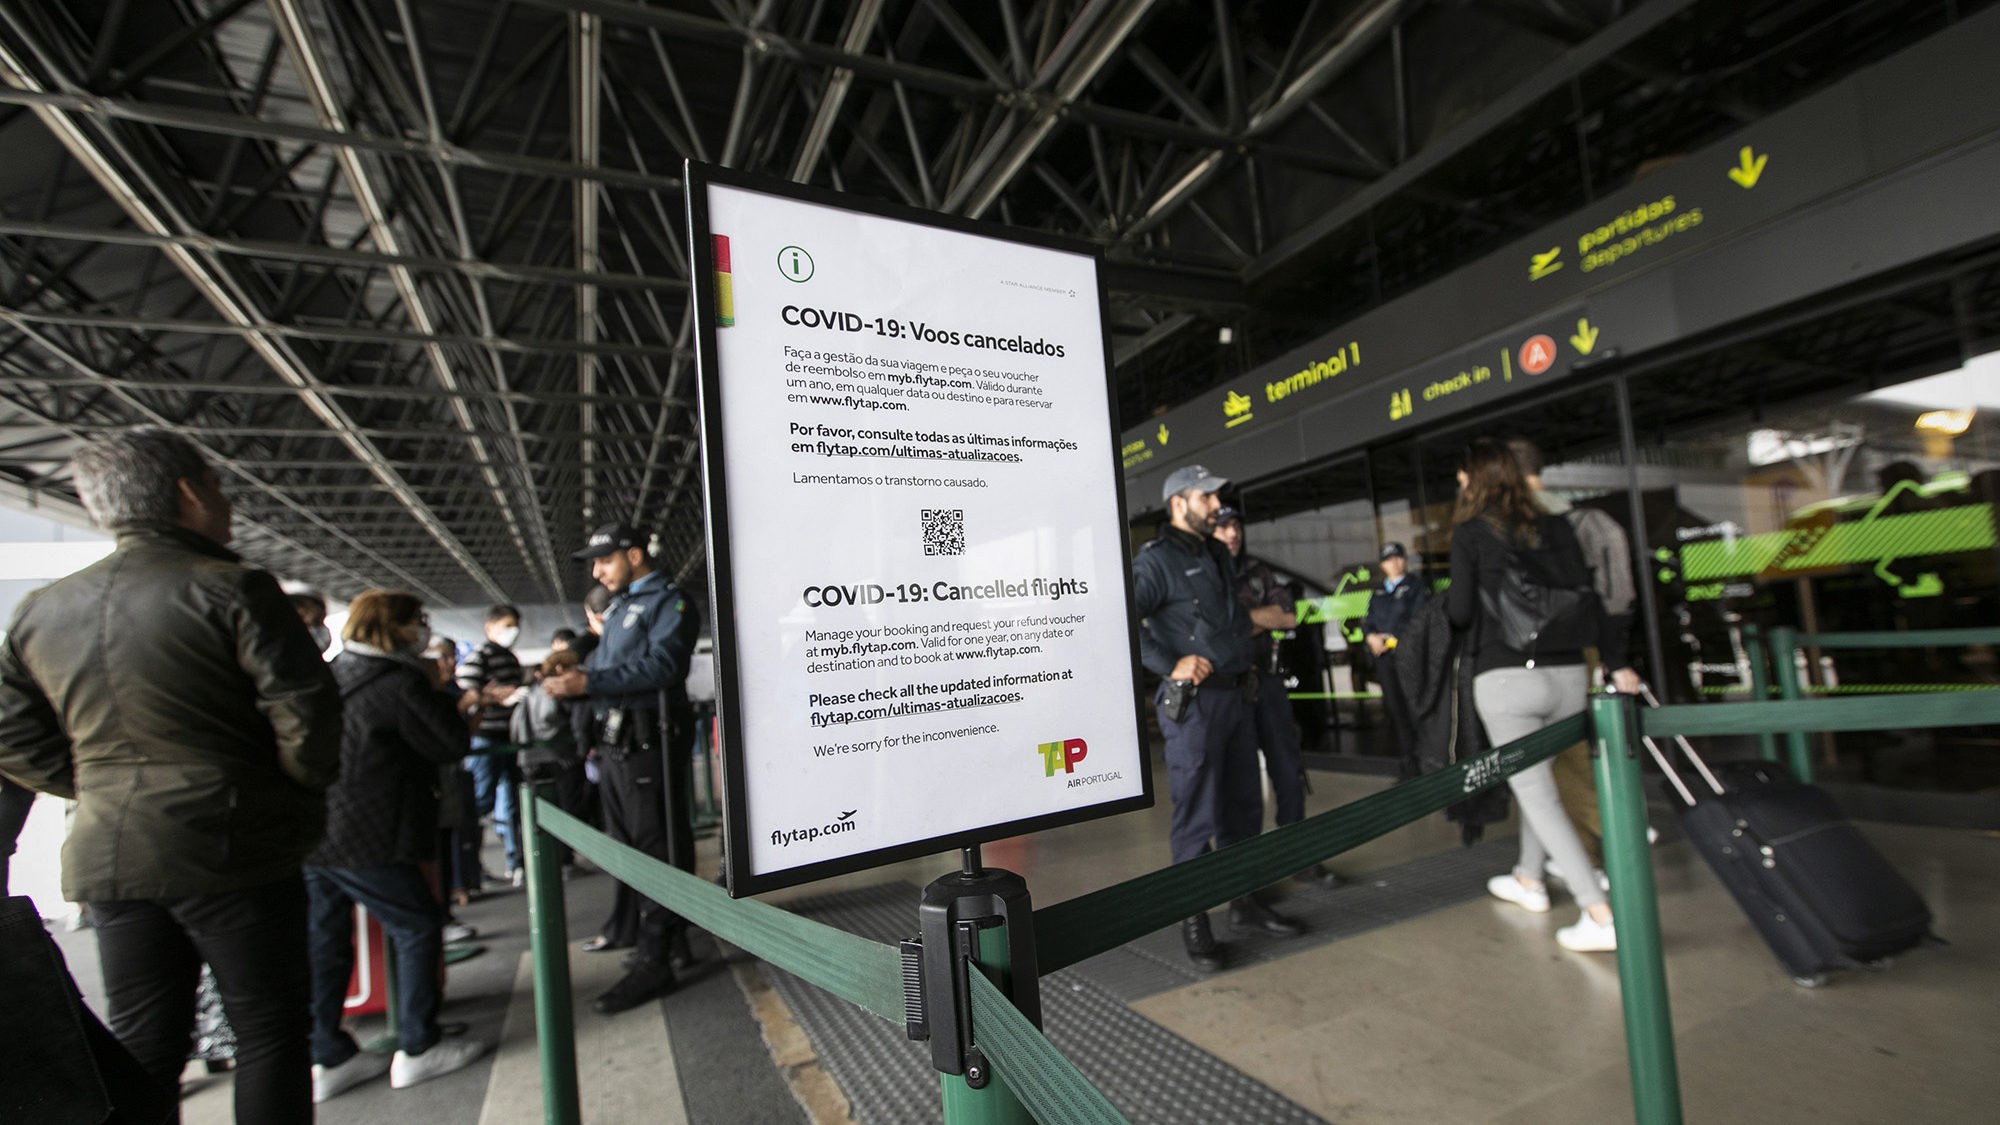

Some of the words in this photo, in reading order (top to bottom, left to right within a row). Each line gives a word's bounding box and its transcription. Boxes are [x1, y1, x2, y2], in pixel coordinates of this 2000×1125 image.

[1578, 195, 1676, 255] partidas
[1580, 208, 1703, 272] departures
[781, 305, 906, 339] COVID-19:
[909, 322, 960, 346] Voos
[963, 333, 1065, 358] cancelados
[784, 345, 812, 362] Faça
[813, 351, 821, 360] a
[822, 352, 864, 366] gestão
[864, 354, 879, 366] da
[880, 358, 900, 368] sua
[900, 359, 939, 374] viagem
[940, 365, 948, 375] e
[948, 366, 973, 378] peça
[973, 369, 982, 377] o
[982, 369, 1000, 379] seu
[1001, 371, 1039, 382] voucher
[785, 361, 801, 373] de
[803, 365, 867, 380] reembolso
[867, 371, 886, 383] em
[887, 372, 975, 390] myb.flytap.com.
[975, 378, 1006, 393] Válido
[1006, 383, 1043, 396] durante
[1266, 347, 1347, 402] terminal
[1350, 341, 1360, 366] 1
[786, 378, 807, 388] um
[808, 380, 834, 395] ano,
[835, 382, 855, 393] em
[856, 384, 905, 399] qualquer
[906, 385, 930, 399] data
[931, 391, 945, 400] ou
[946, 390, 985, 404] destino
[985, 395, 992, 403] e
[993, 393, 1014, 407] para
[1015, 399, 1053, 409] reservar
[1423, 371, 1472, 401] check
[1472, 365, 1491, 384] in
[787, 392, 808, 403] em
[809, 394, 910, 412] www.flytap.com.
[790, 422, 815, 436] Por
[816, 423, 856, 441] favor,
[857, 428, 914, 442] consulte
[914, 430, 950, 445] todas
[951, 435, 966, 444] as
[967, 433, 1010, 447] últimas
[1011, 435, 1078, 453] informações
[791, 442, 815, 453] em
[816, 441, 1023, 463] flytap.com/ultimas-atualizacoes.
[793, 472, 874, 485] Lamentamos
[874, 476, 883, 486] o
[884, 475, 943, 487] transtorno
[943, 477, 989, 488] causado.
[803, 583, 929, 608] COVID-19:
[932, 578, 1029, 602] Cancelled
[1030, 577, 1089, 601] flights
[805, 629, 854, 642] Manage
[855, 628, 882, 641] your
[884, 623, 929, 637] booking
[930, 621, 951, 634] and
[951, 619, 992, 633] request
[993, 619, 1015, 631] your
[1016, 616, 1048, 627] refund
[1048, 613, 1086, 625] voucher
[805, 646, 820, 658] at
[820, 641, 919, 659] myb.flytap.com.
[920, 636, 946, 649] Valid
[947, 635, 963, 647] for
[964, 634, 984, 646] one
[985, 633, 1009, 647] year,
[1010, 632, 1023, 642] on
[1024, 630, 1042, 642] any
[1042, 627, 1064, 639] date
[1064, 628, 1074, 637] or
[806, 658, 875, 674] destination
[877, 655, 898, 668] and
[900, 654, 913, 666] to
[913, 652, 942, 664] book
[943, 650, 954, 662] at
[955, 645, 1043, 660] www.flytap.com.
[809, 693, 856, 708] Please
[857, 686, 899, 702] check
[899, 684, 915, 698] all
[915, 682, 939, 696] the
[939, 676, 991, 696] updated
[992, 670, 1060, 688] information
[1061, 668, 1074, 680] at
[810, 691, 1024, 727] flytap.com/ultimas-atualizacoes.
[813, 743, 851, 757] We're
[851, 740, 882, 753] sorry
[883, 735, 900, 748] for
[901, 733, 921, 745] the
[922, 724, 1000, 743] inconvenience.
[1038, 738, 1087, 777] TAP
[771, 820, 856, 847] flytap.com
